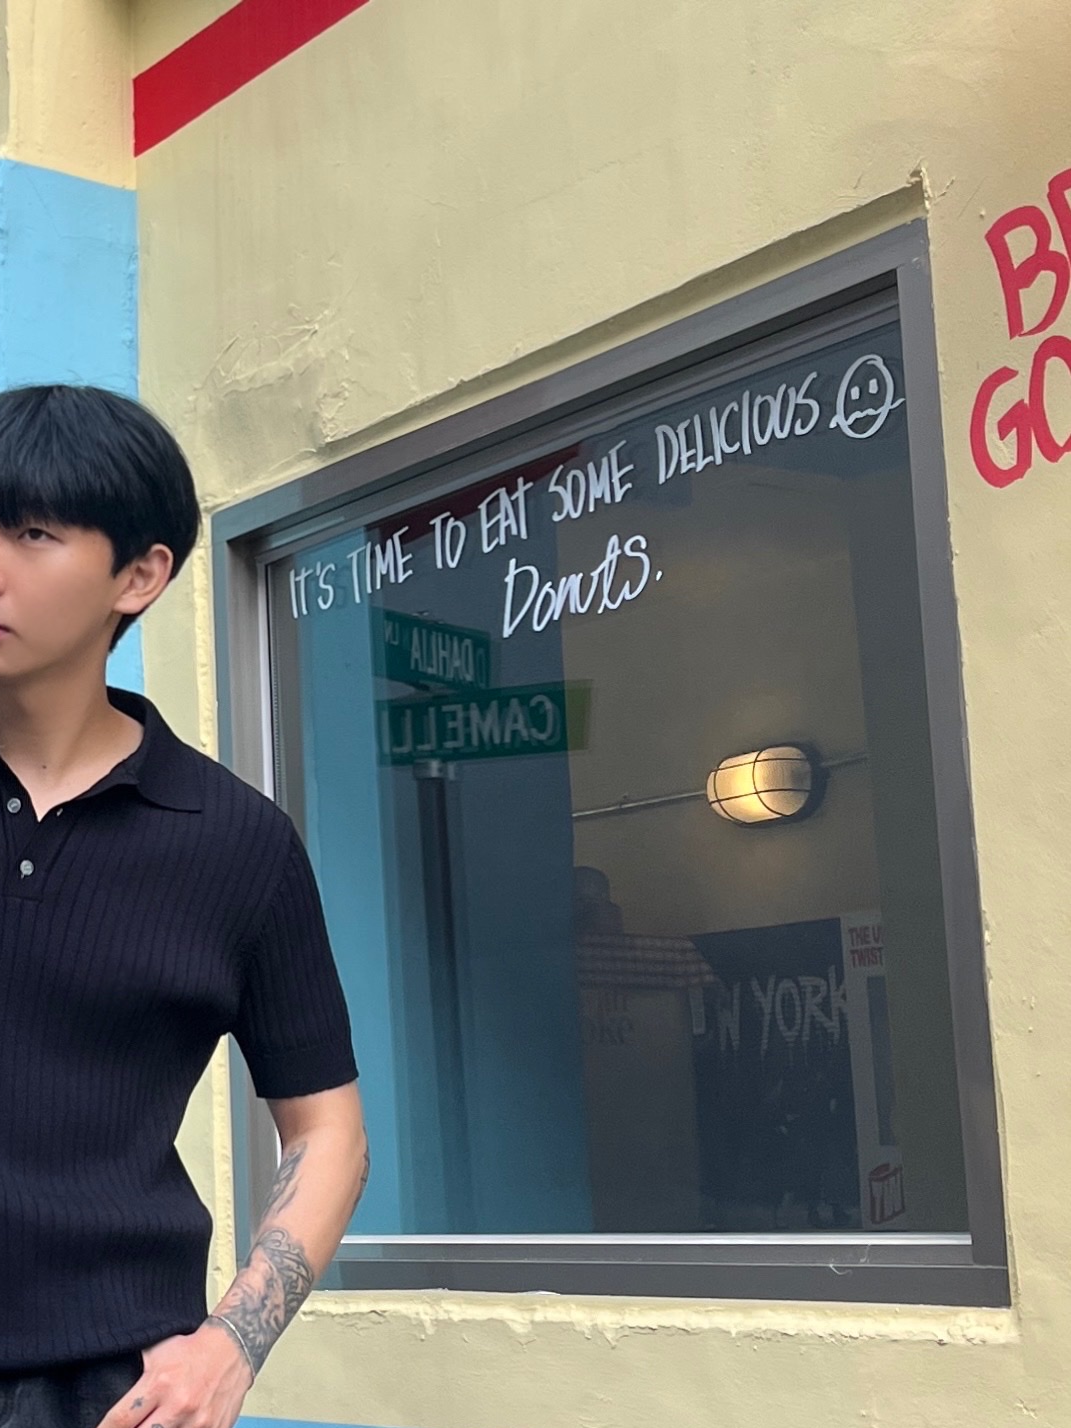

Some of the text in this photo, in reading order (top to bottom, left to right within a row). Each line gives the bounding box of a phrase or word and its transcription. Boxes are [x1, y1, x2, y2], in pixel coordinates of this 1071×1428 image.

[289, 371, 820, 619] IT'S TIME TO EAT SOME DELICIOUS
